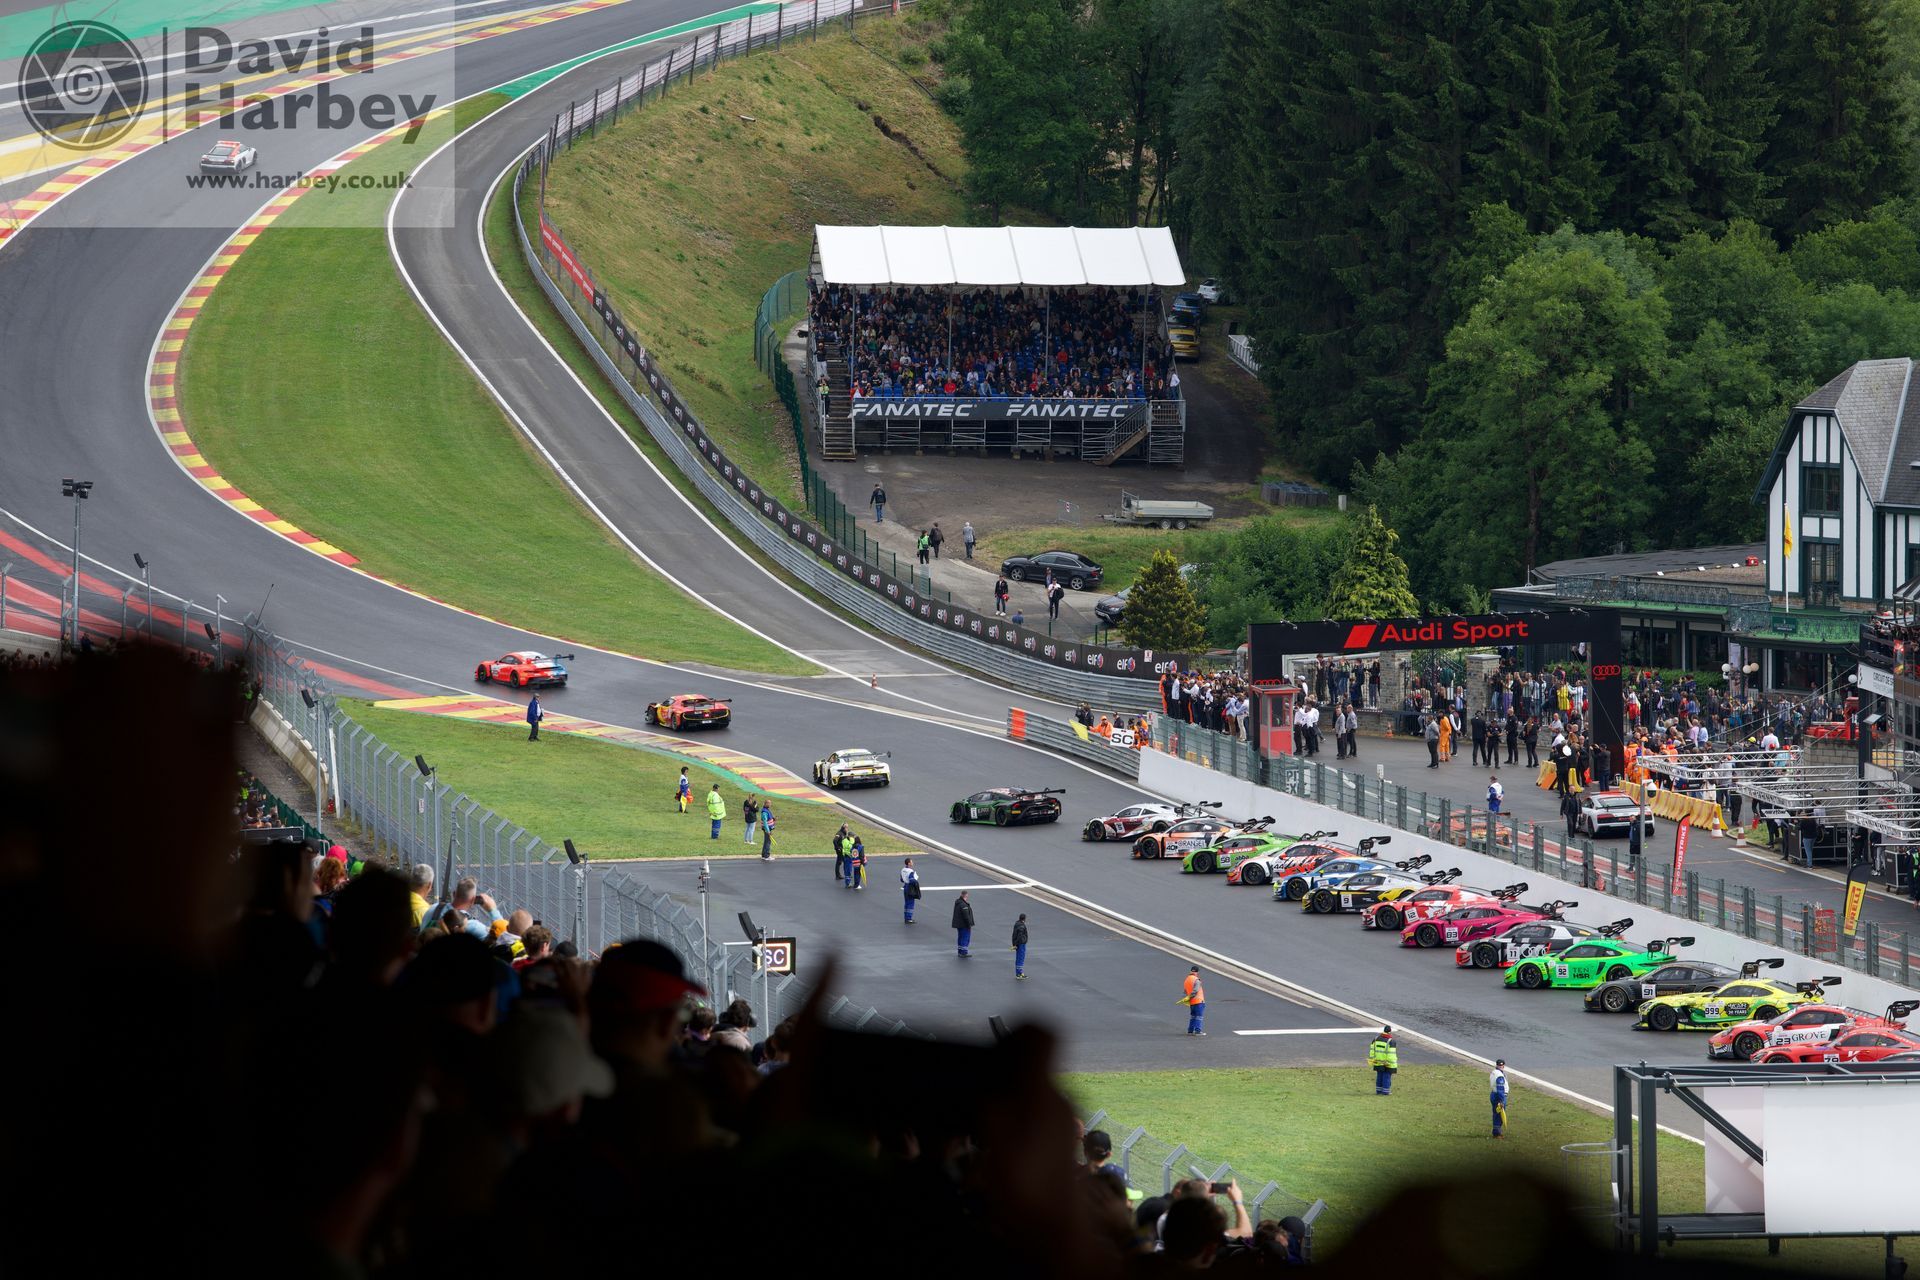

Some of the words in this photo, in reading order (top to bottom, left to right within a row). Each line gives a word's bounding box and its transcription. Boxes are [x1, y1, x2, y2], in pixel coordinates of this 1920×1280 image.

[853, 404, 973, 417] FANATEC
[1006, 404, 1128, 417] FANATEC
[1380, 623, 1443, 643] Audi
[1452, 621, 1528, 644] Sport
[1087, 654, 1098, 666] elf
[1117, 659, 1129, 671] elf
[1111, 733, 1133, 745] SC
[1558, 968, 1567, 976] 92
[1643, 988, 1653, 996] 91
[1705, 1007, 1720, 1015] 999
[1776, 1037, 1791, 1046] 23
[1791, 1030, 1827, 1042] GROVE
